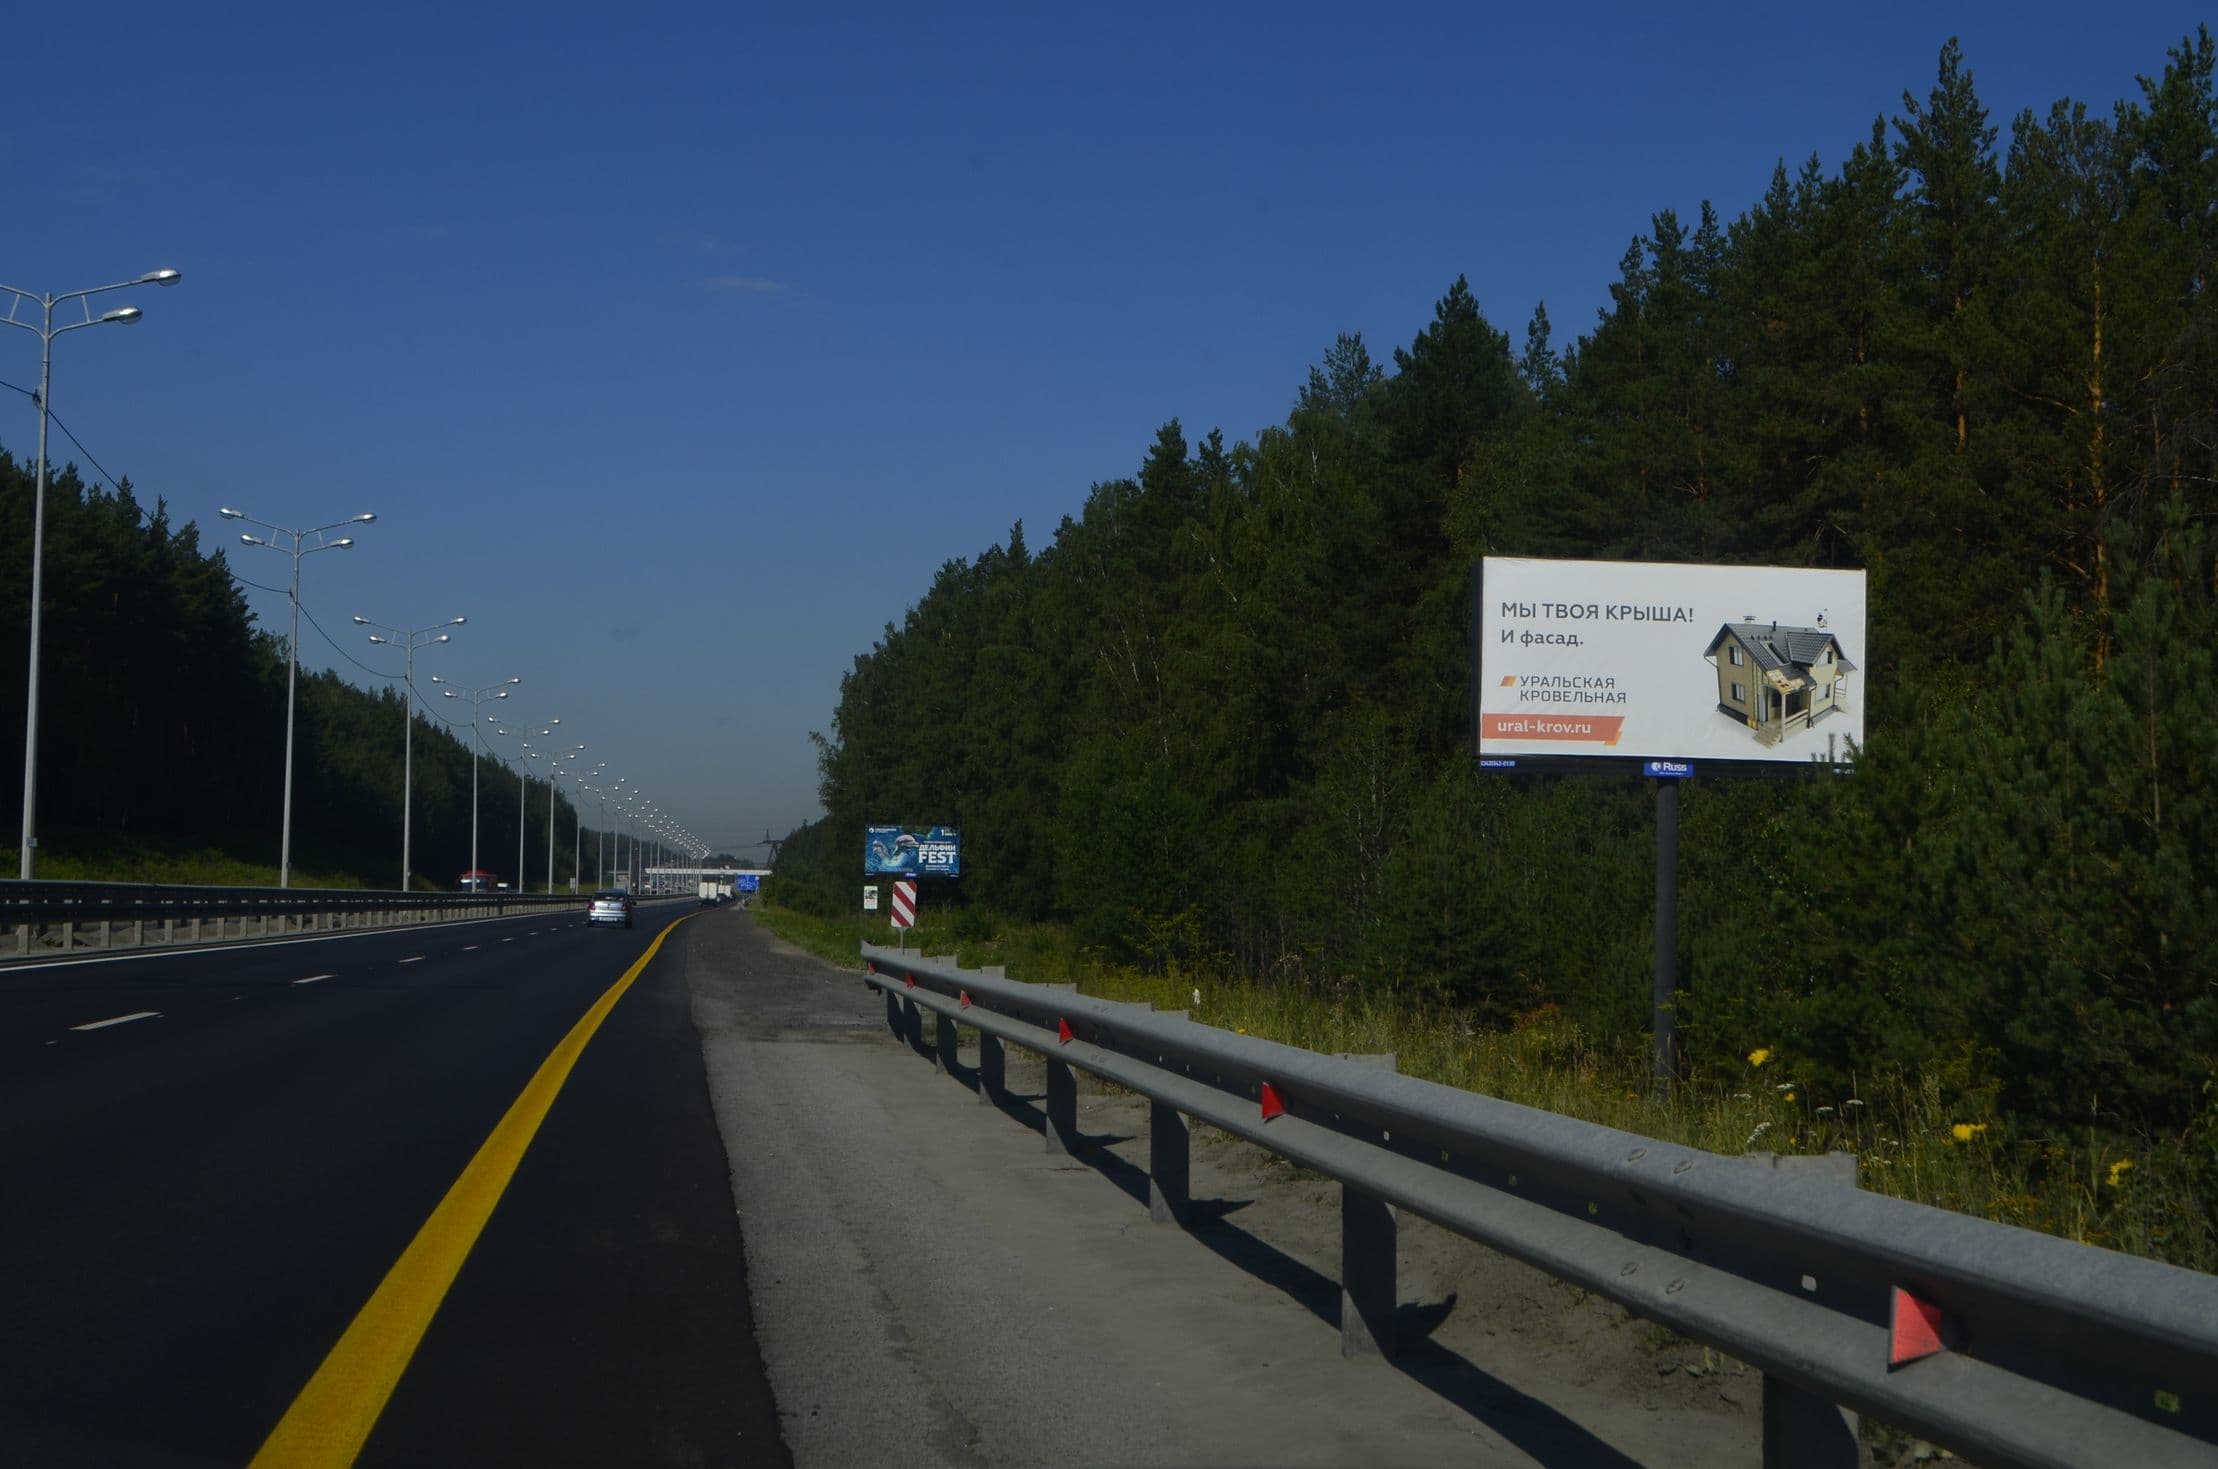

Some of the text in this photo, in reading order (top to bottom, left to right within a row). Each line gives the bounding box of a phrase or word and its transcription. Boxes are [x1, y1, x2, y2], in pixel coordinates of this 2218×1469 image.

[1501, 602, 1694, 623] МЫ ТВОЯ КРЫША!
[1501, 629, 1584, 648] И фасад.
[1519, 675, 1615, 689] УРАЛЬСКАЯ
[1519, 690, 1627, 704] КРОВЕЛЬНАЯ
[1497, 718, 1592, 735] ural-krov.ru
[1663, 762, 1687, 772] Russ
[919, 844, 956, 852] ДЕЛЬФИН
[918, 851, 957, 864] FEST
